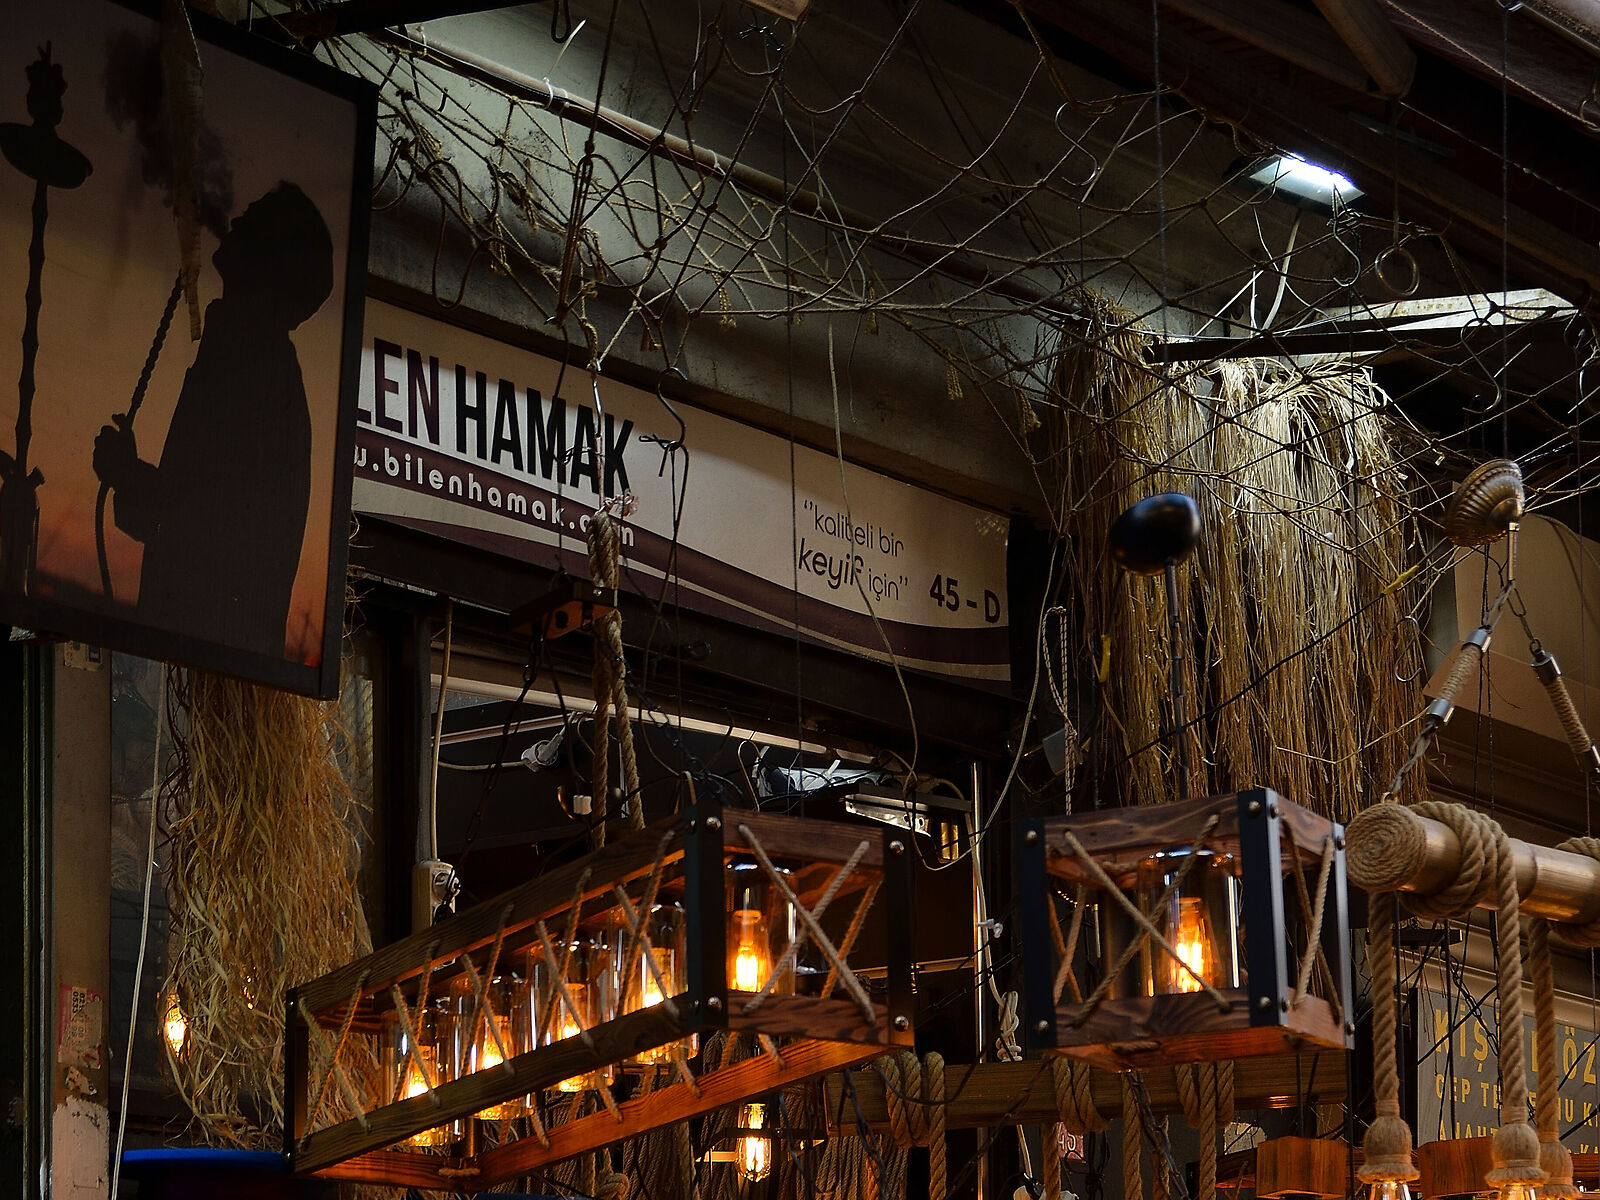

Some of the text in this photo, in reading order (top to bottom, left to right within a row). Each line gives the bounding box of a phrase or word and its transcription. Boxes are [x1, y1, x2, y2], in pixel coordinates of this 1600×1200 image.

[357, 337, 634, 499] EN HAMAK
[798, 537, 864, 590] keyif
[879, 527, 904, 557] bir
[930, 573, 960, 612] 45
